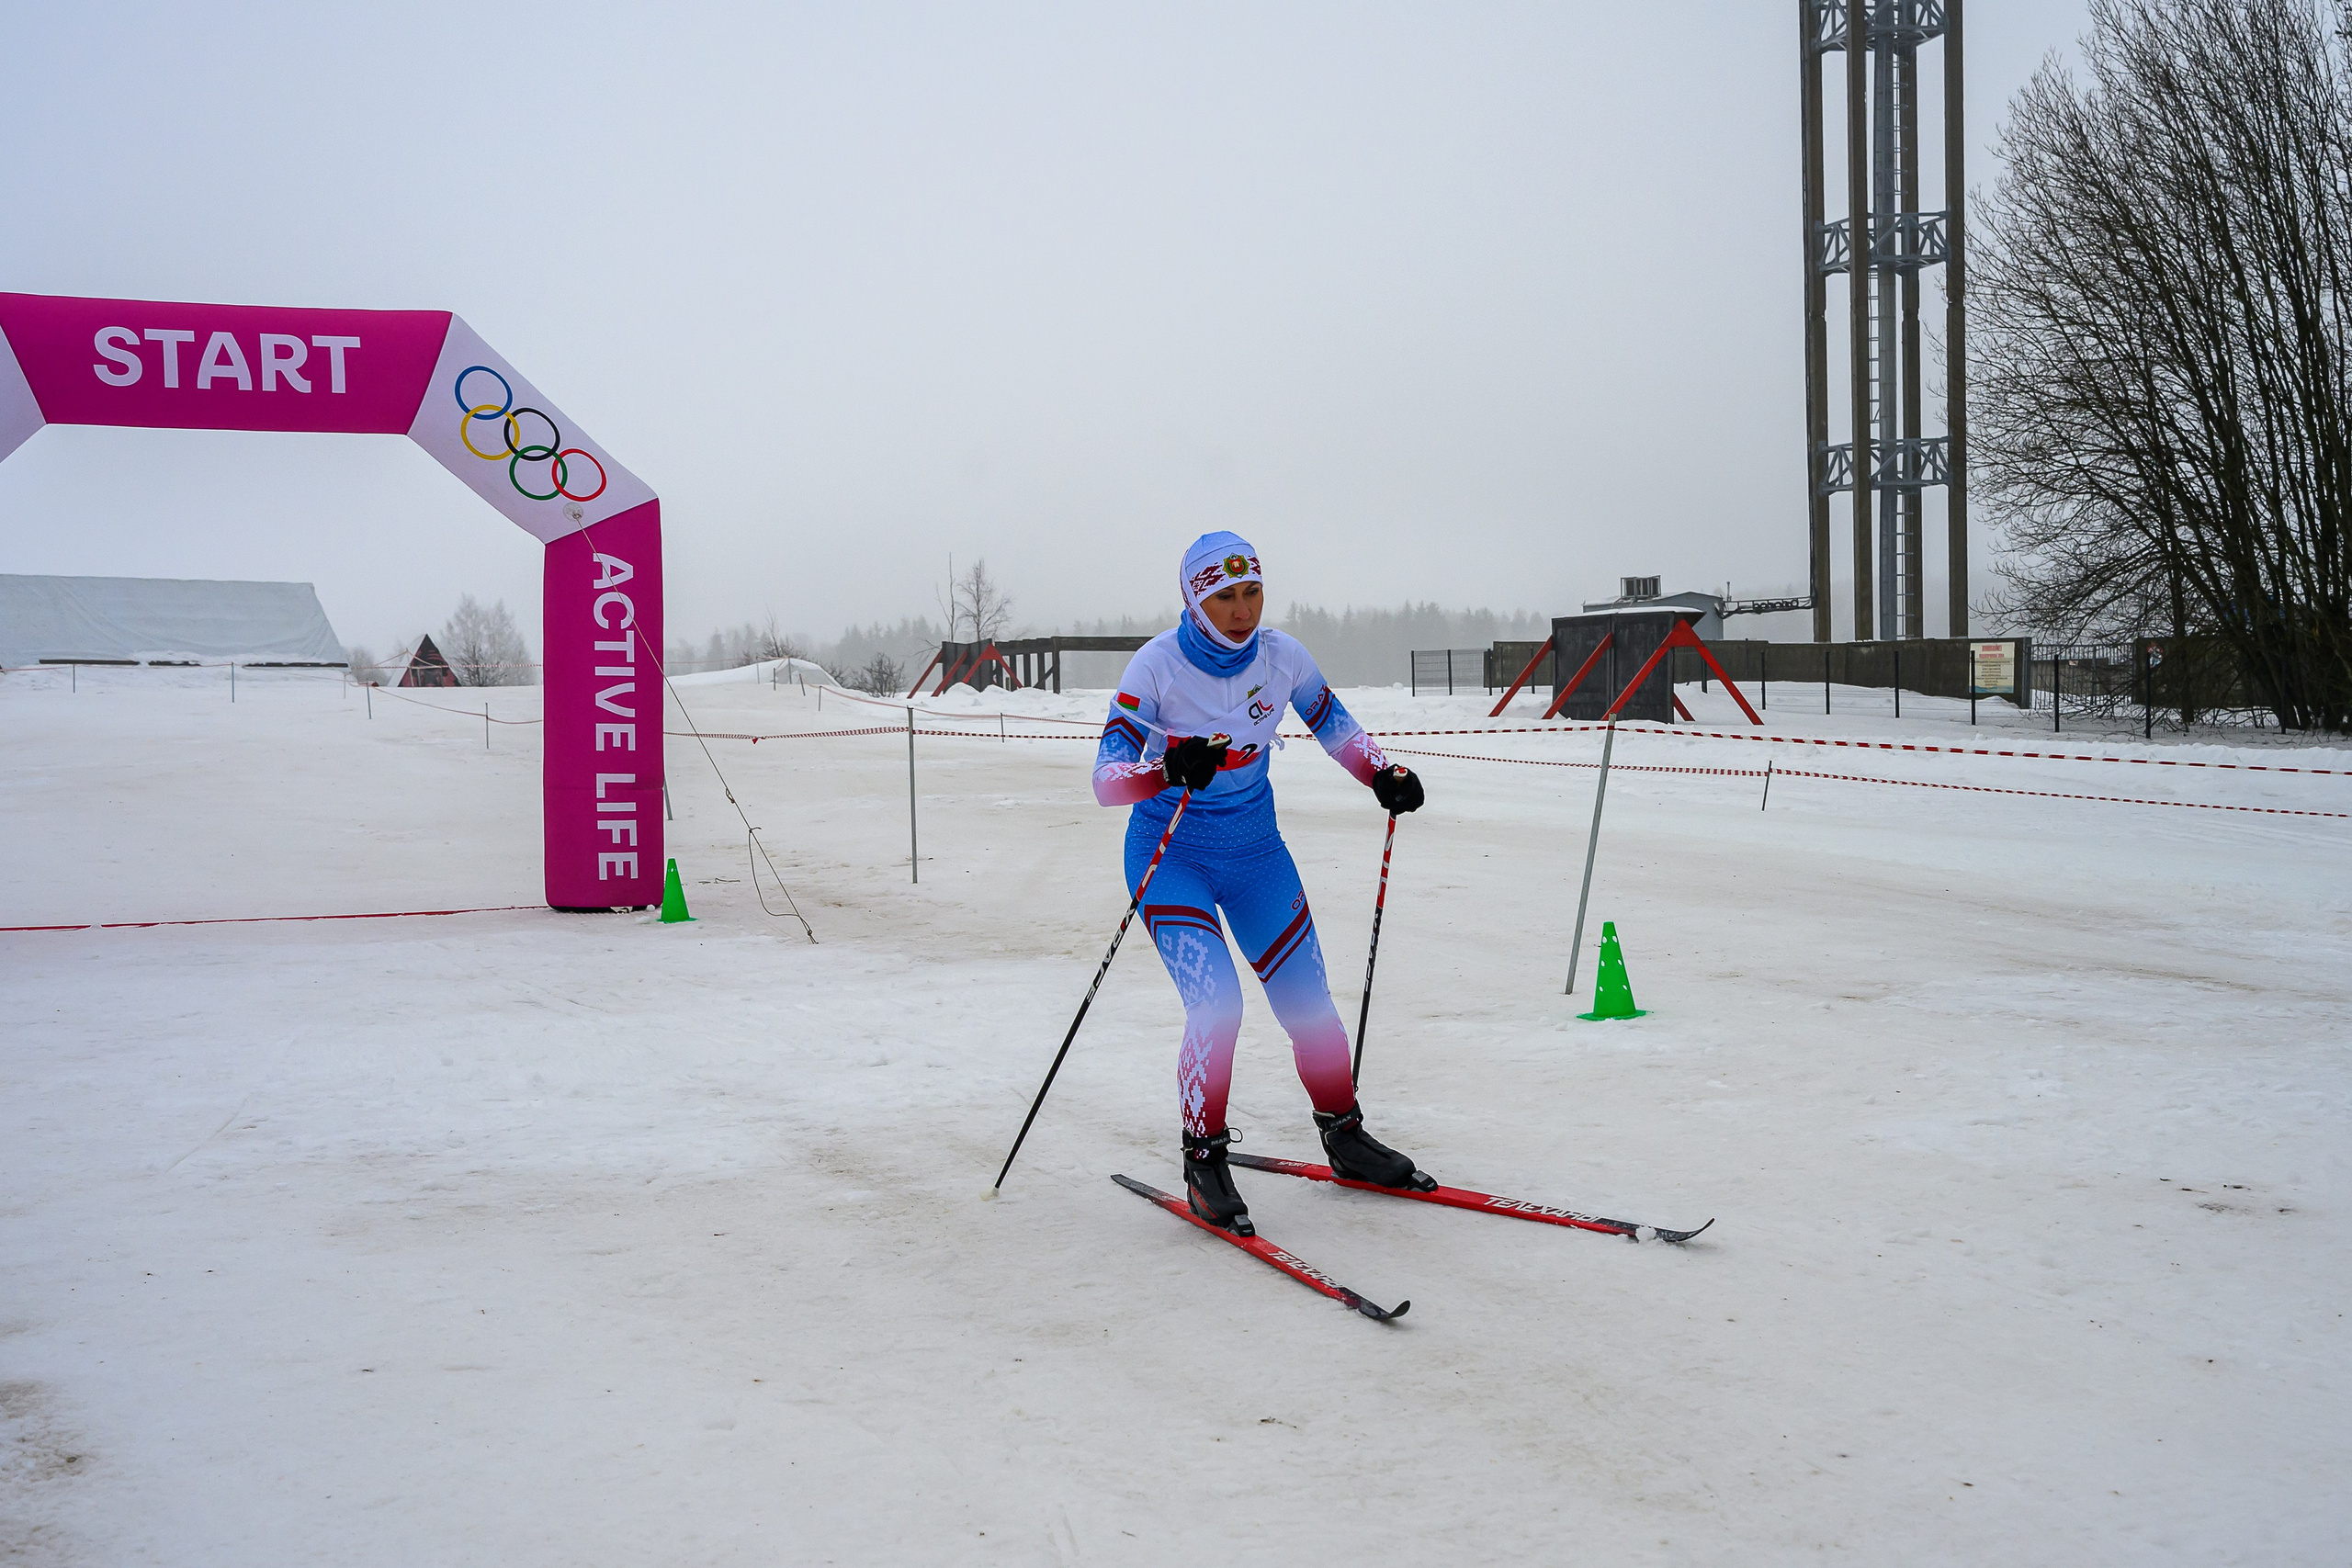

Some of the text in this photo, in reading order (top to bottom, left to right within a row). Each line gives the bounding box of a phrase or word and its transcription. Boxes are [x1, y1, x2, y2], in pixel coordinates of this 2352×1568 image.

[93, 326, 361, 394] START
[593, 552, 639, 881] ACTIVE LIFE
